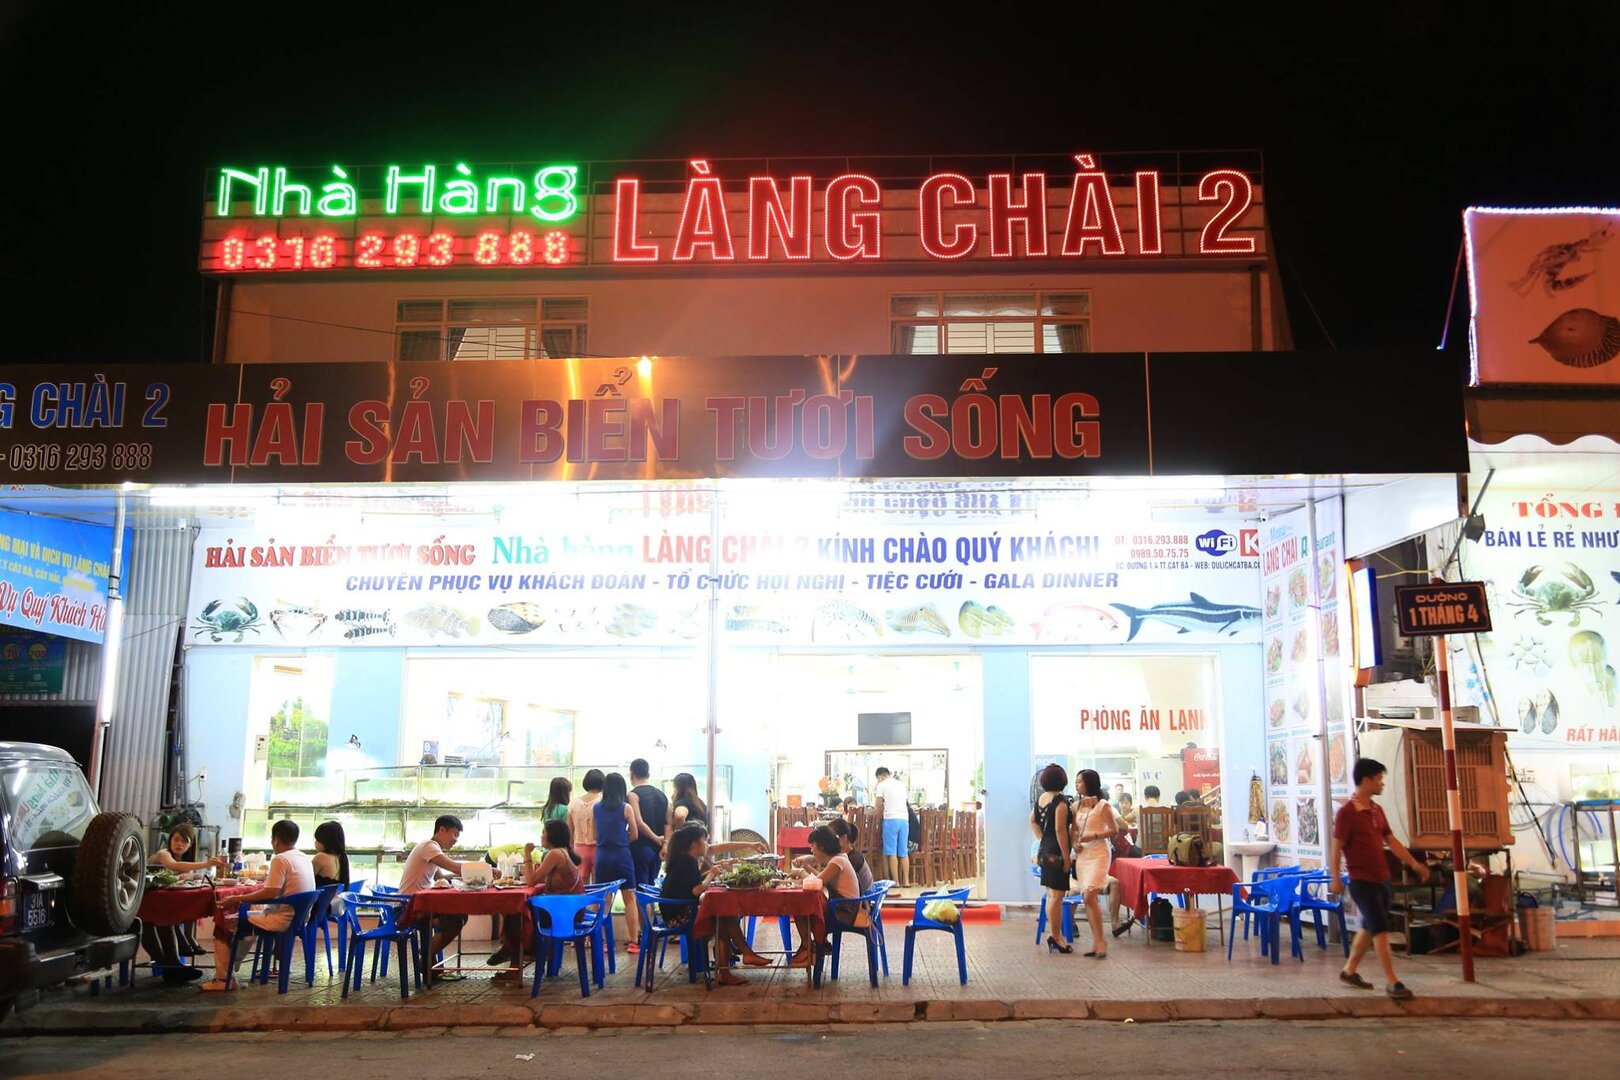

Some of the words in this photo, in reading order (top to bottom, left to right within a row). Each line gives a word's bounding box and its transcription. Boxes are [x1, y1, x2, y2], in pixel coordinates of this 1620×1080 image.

[217, 164, 357, 216] Nhà
[385, 163, 578, 221] Hàng
[613, 160, 881, 261] LÀNG
[918, 154, 1162, 260] CHÀI
[1198, 170, 1255, 254] 2
[223, 235, 337, 268] 0316
[357, 233, 454, 267] 293
[474, 231, 570, 265] 888
[30, 373, 127, 429] CHÀI
[142, 382, 171, 428] 2
[203, 377, 325, 466] HẢI
[345, 376, 496, 465] SẢN
[519, 366, 682, 463] BIỂN
[706, 388, 876, 461] TƯƠI
[903, 366, 1102, 460] SỐNG
[9, 443, 61, 471] 0316
[65, 443, 106, 471] 293
[112, 443, 152, 470] 888
[1512, 493, 1603, 518] TỔNG
[492, 536, 549, 564] Nhà
[642, 529, 711, 564] LÀNG
[818, 531, 874, 563] KÍNH
[883, 531, 947, 564] CHÀO
[955, 531, 1002, 566] QUÝ
[1132, 535, 1189, 545] 0316.293.888
[1527, 524, 1547, 548] LẺ
[1553, 524, 1576, 548] RẺ
[205, 538, 246, 568] HẢI
[250, 537, 296, 568] SẢN
[416, 535, 476, 568] SỐNG
[1130, 548, 1189, 558] 0989.50.75.75
[1194, 561, 1210, 569] WEB:
[429, 574, 482, 593] PHỤC
[488, 574, 513, 594] VỤ
[518, 571, 585, 590] KHÁCH
[866, 571, 908, 592] TIỆC
[915, 569, 963, 590] CƯỚI
[984, 572, 1035, 589] GALA
[1042, 571, 1118, 589] DINNER
[21, 587, 49, 626] Quý
[49, 595, 87, 627] Khách
[1408, 607, 1417, 627] 1
[1418, 603, 1465, 626] THÁNG
[1467, 603, 1479, 623] 4
[1081, 704, 1131, 730] PHÒNG
[1139, 704, 1160, 730] ĂN
